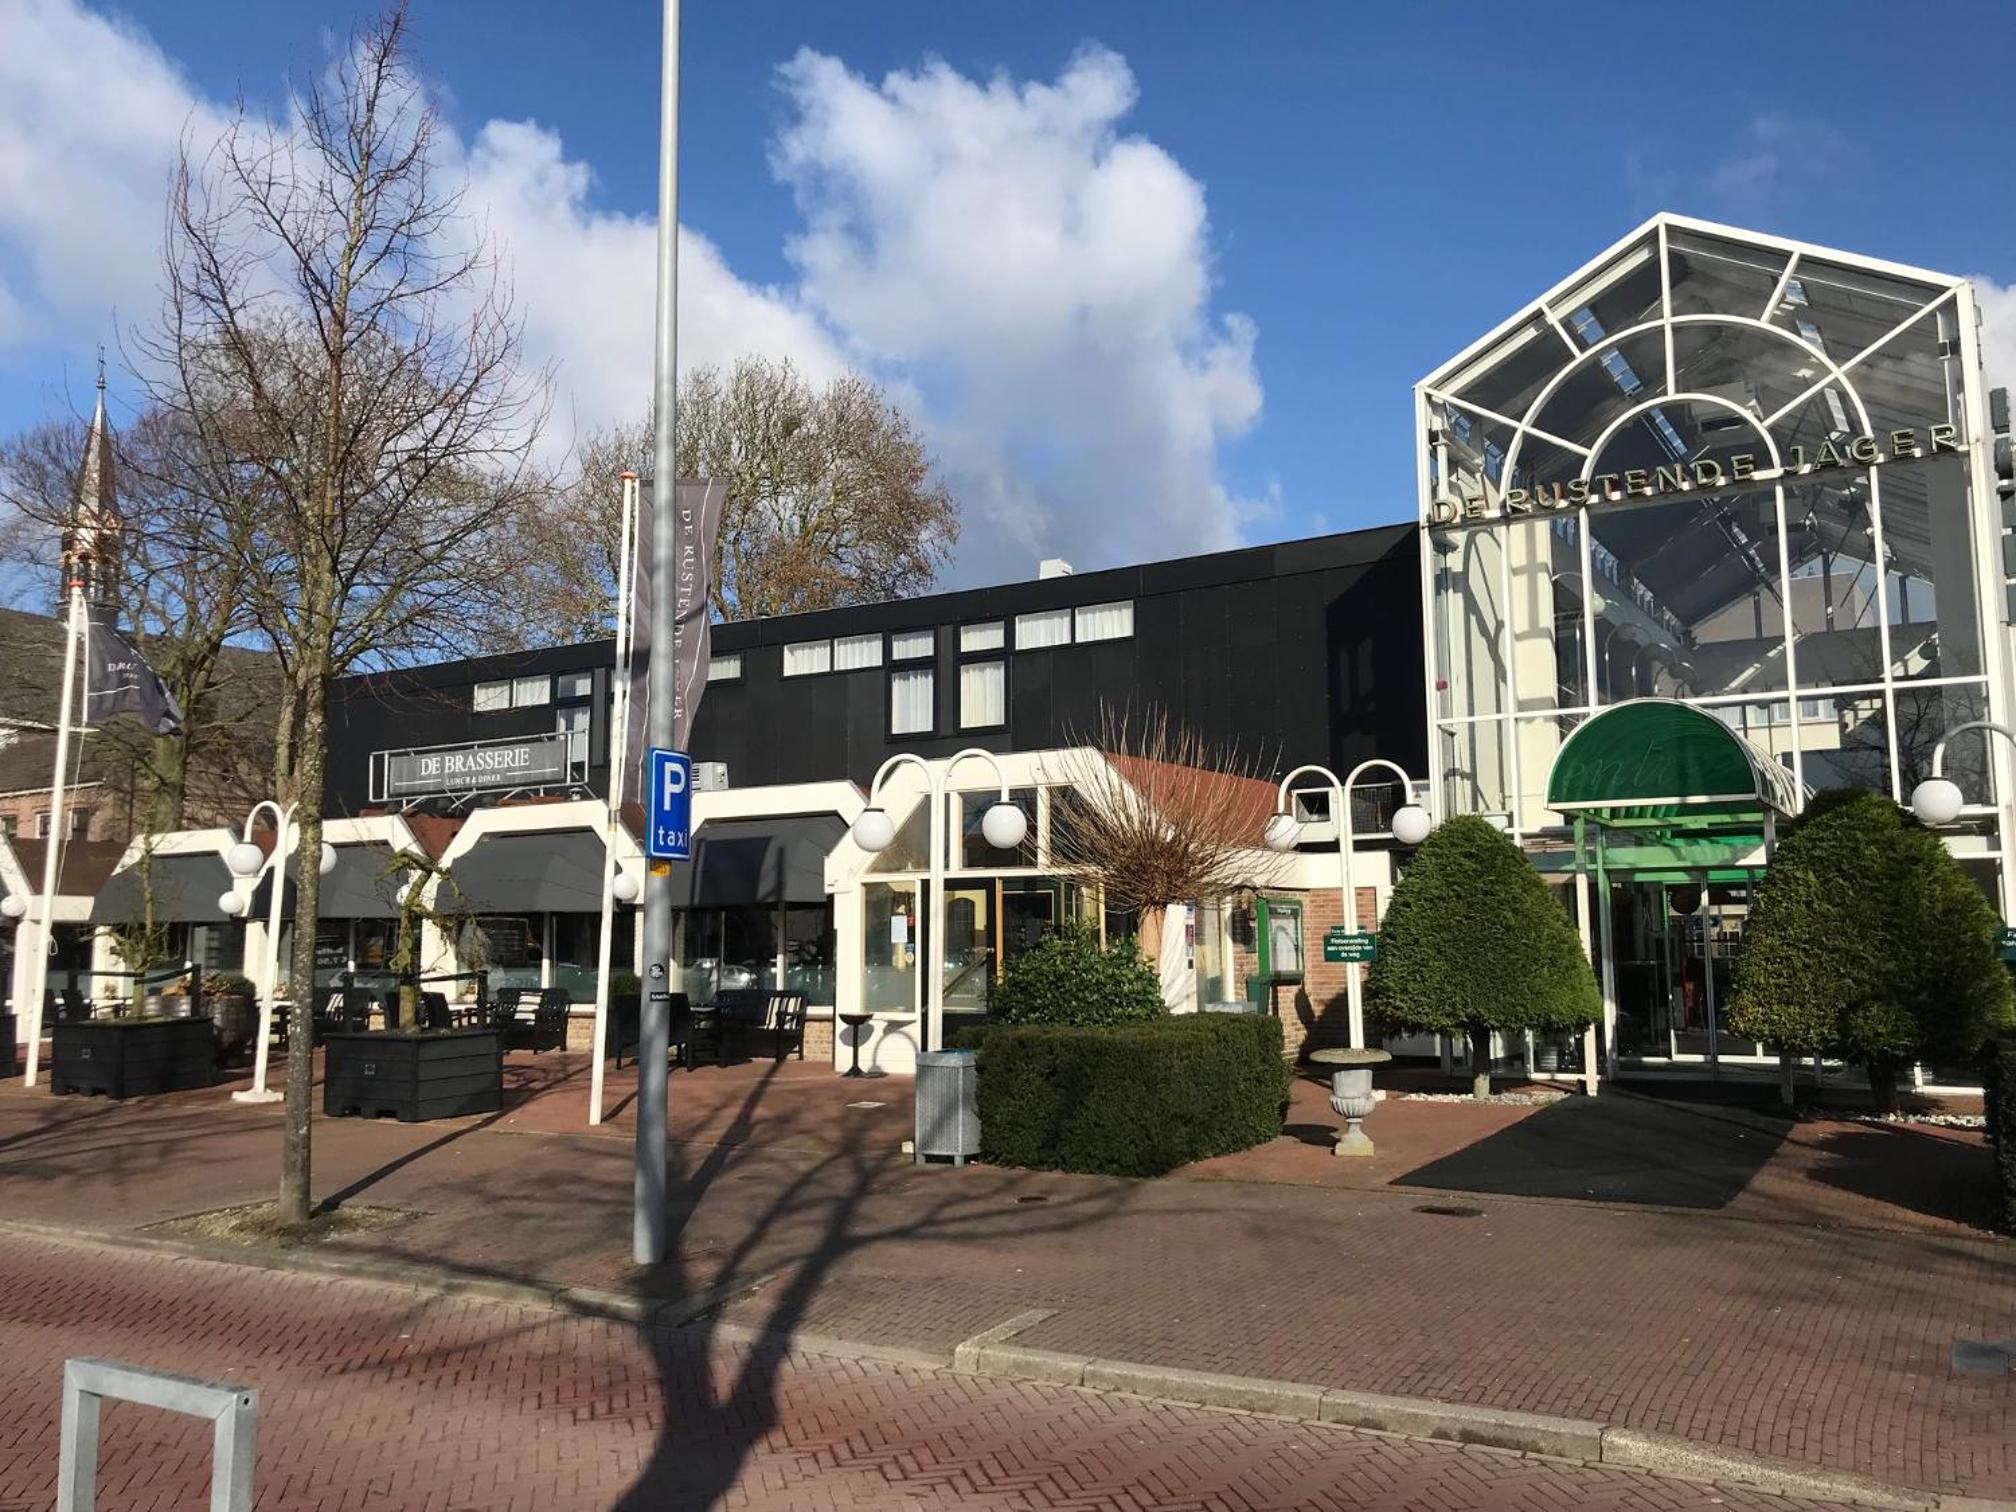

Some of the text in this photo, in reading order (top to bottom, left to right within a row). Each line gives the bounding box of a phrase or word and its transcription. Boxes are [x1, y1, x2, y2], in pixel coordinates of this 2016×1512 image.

[1433, 424, 1959, 523] DE RUSTENDE JAGER
[421, 748, 530, 776] DE BRASSERIE
[663, 761, 686, 811] P
[658, 825, 688, 848] taxi
